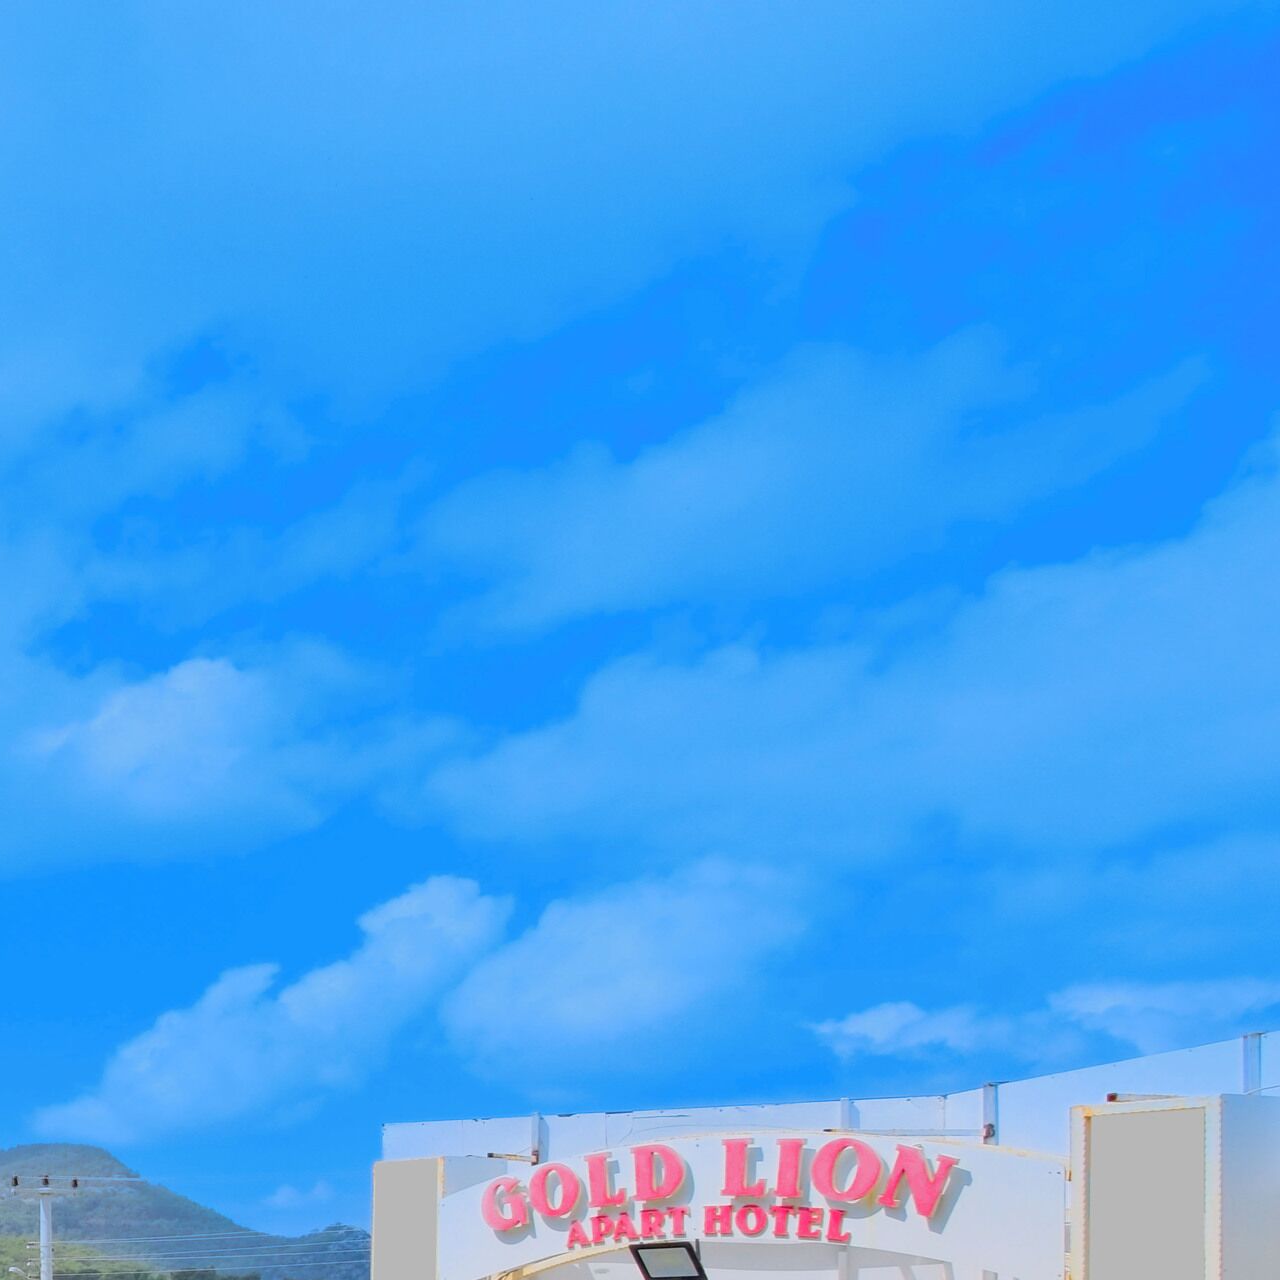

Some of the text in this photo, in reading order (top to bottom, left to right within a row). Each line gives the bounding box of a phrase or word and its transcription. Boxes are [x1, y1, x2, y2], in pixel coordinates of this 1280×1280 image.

[480, 1137, 960, 1232] GOLD LION
[566, 1203, 852, 1249] APART HOTEL
